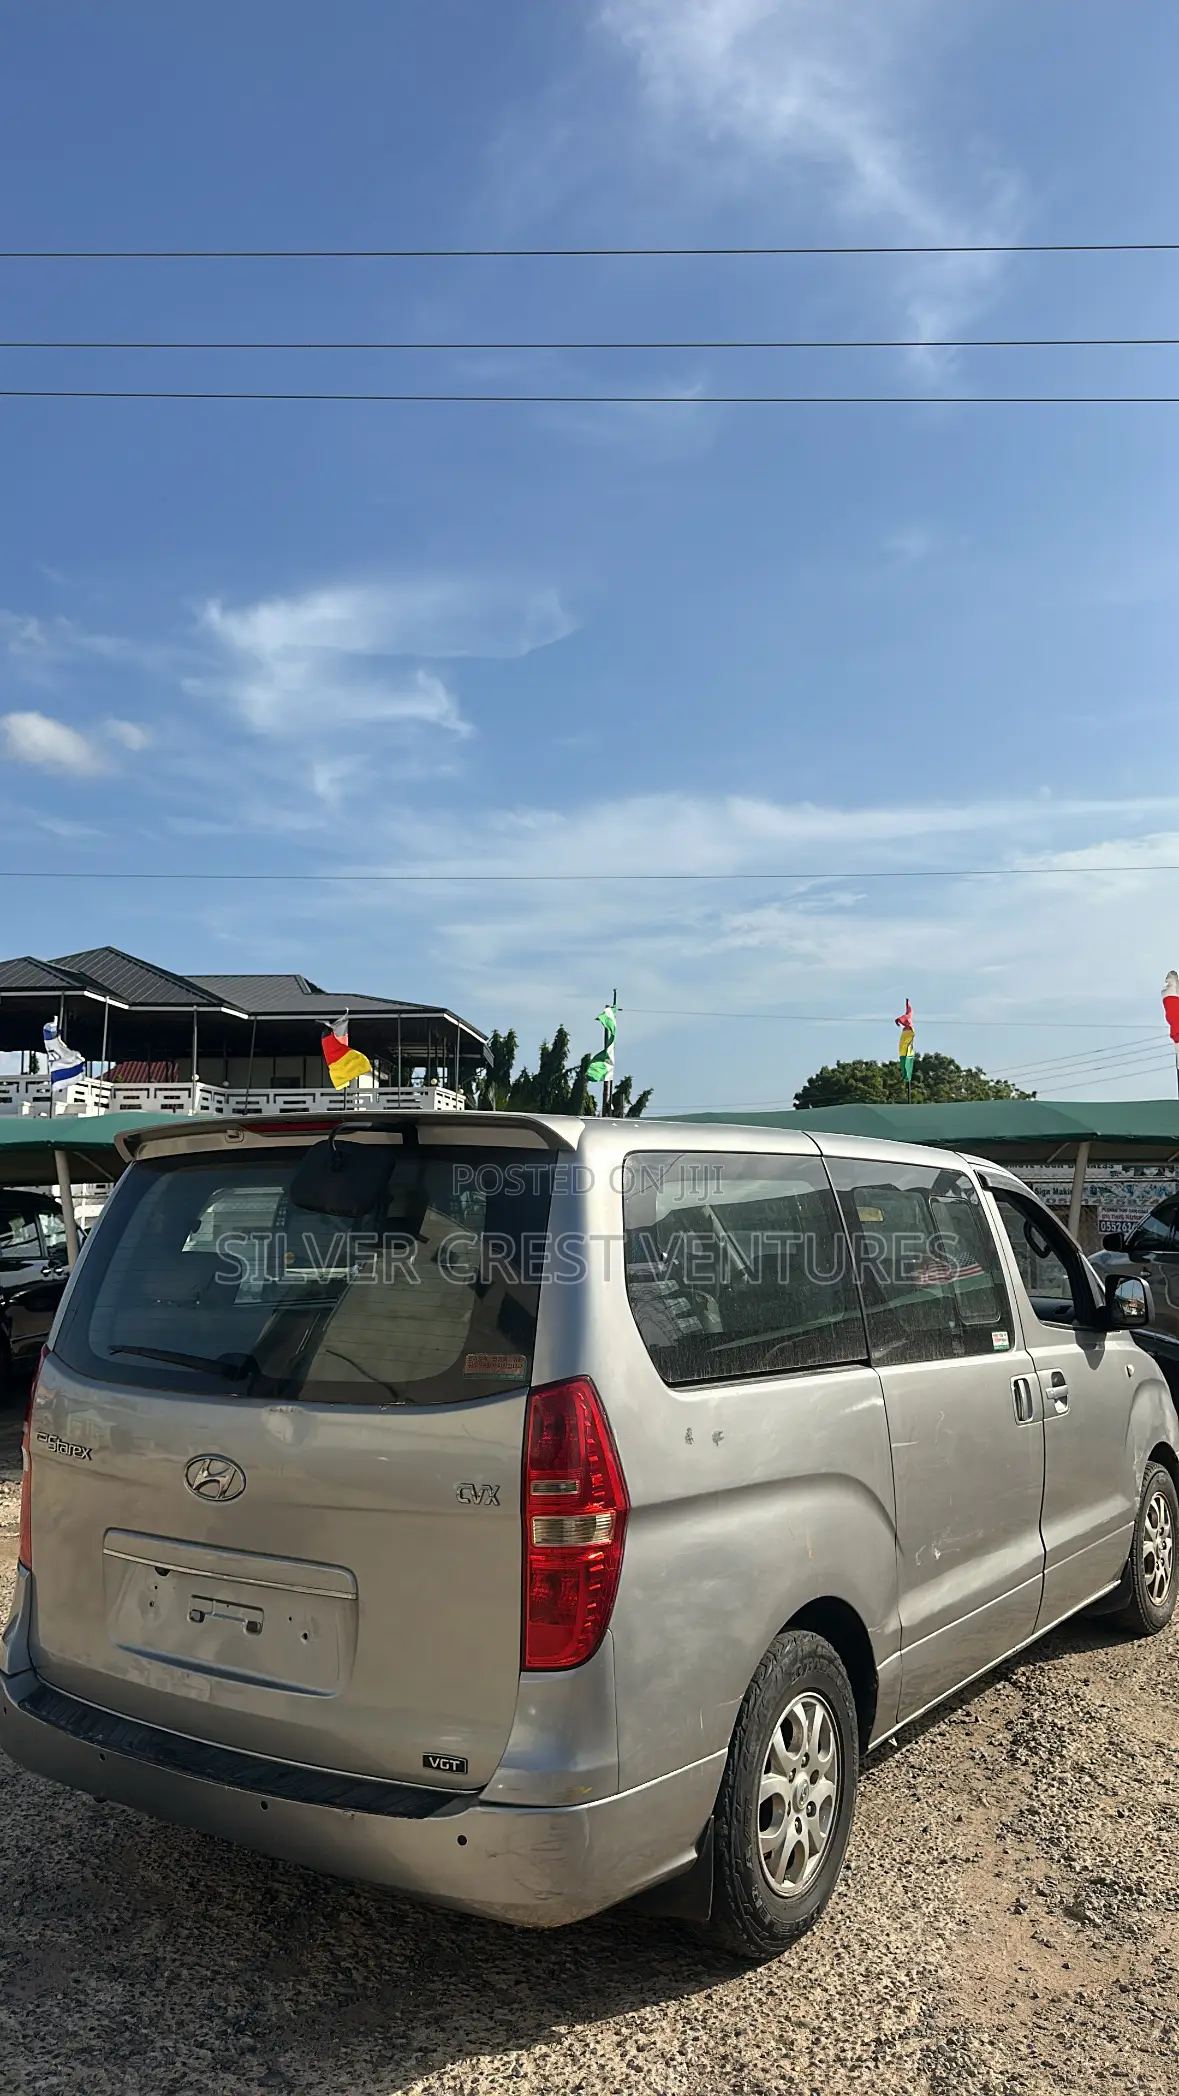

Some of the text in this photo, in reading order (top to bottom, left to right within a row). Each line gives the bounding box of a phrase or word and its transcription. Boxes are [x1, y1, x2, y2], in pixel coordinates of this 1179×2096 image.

[1034, 1187, 1051, 1197] Sign
[456, 1482, 500, 1506] CVX
[428, 1756, 461, 1771] VGT
